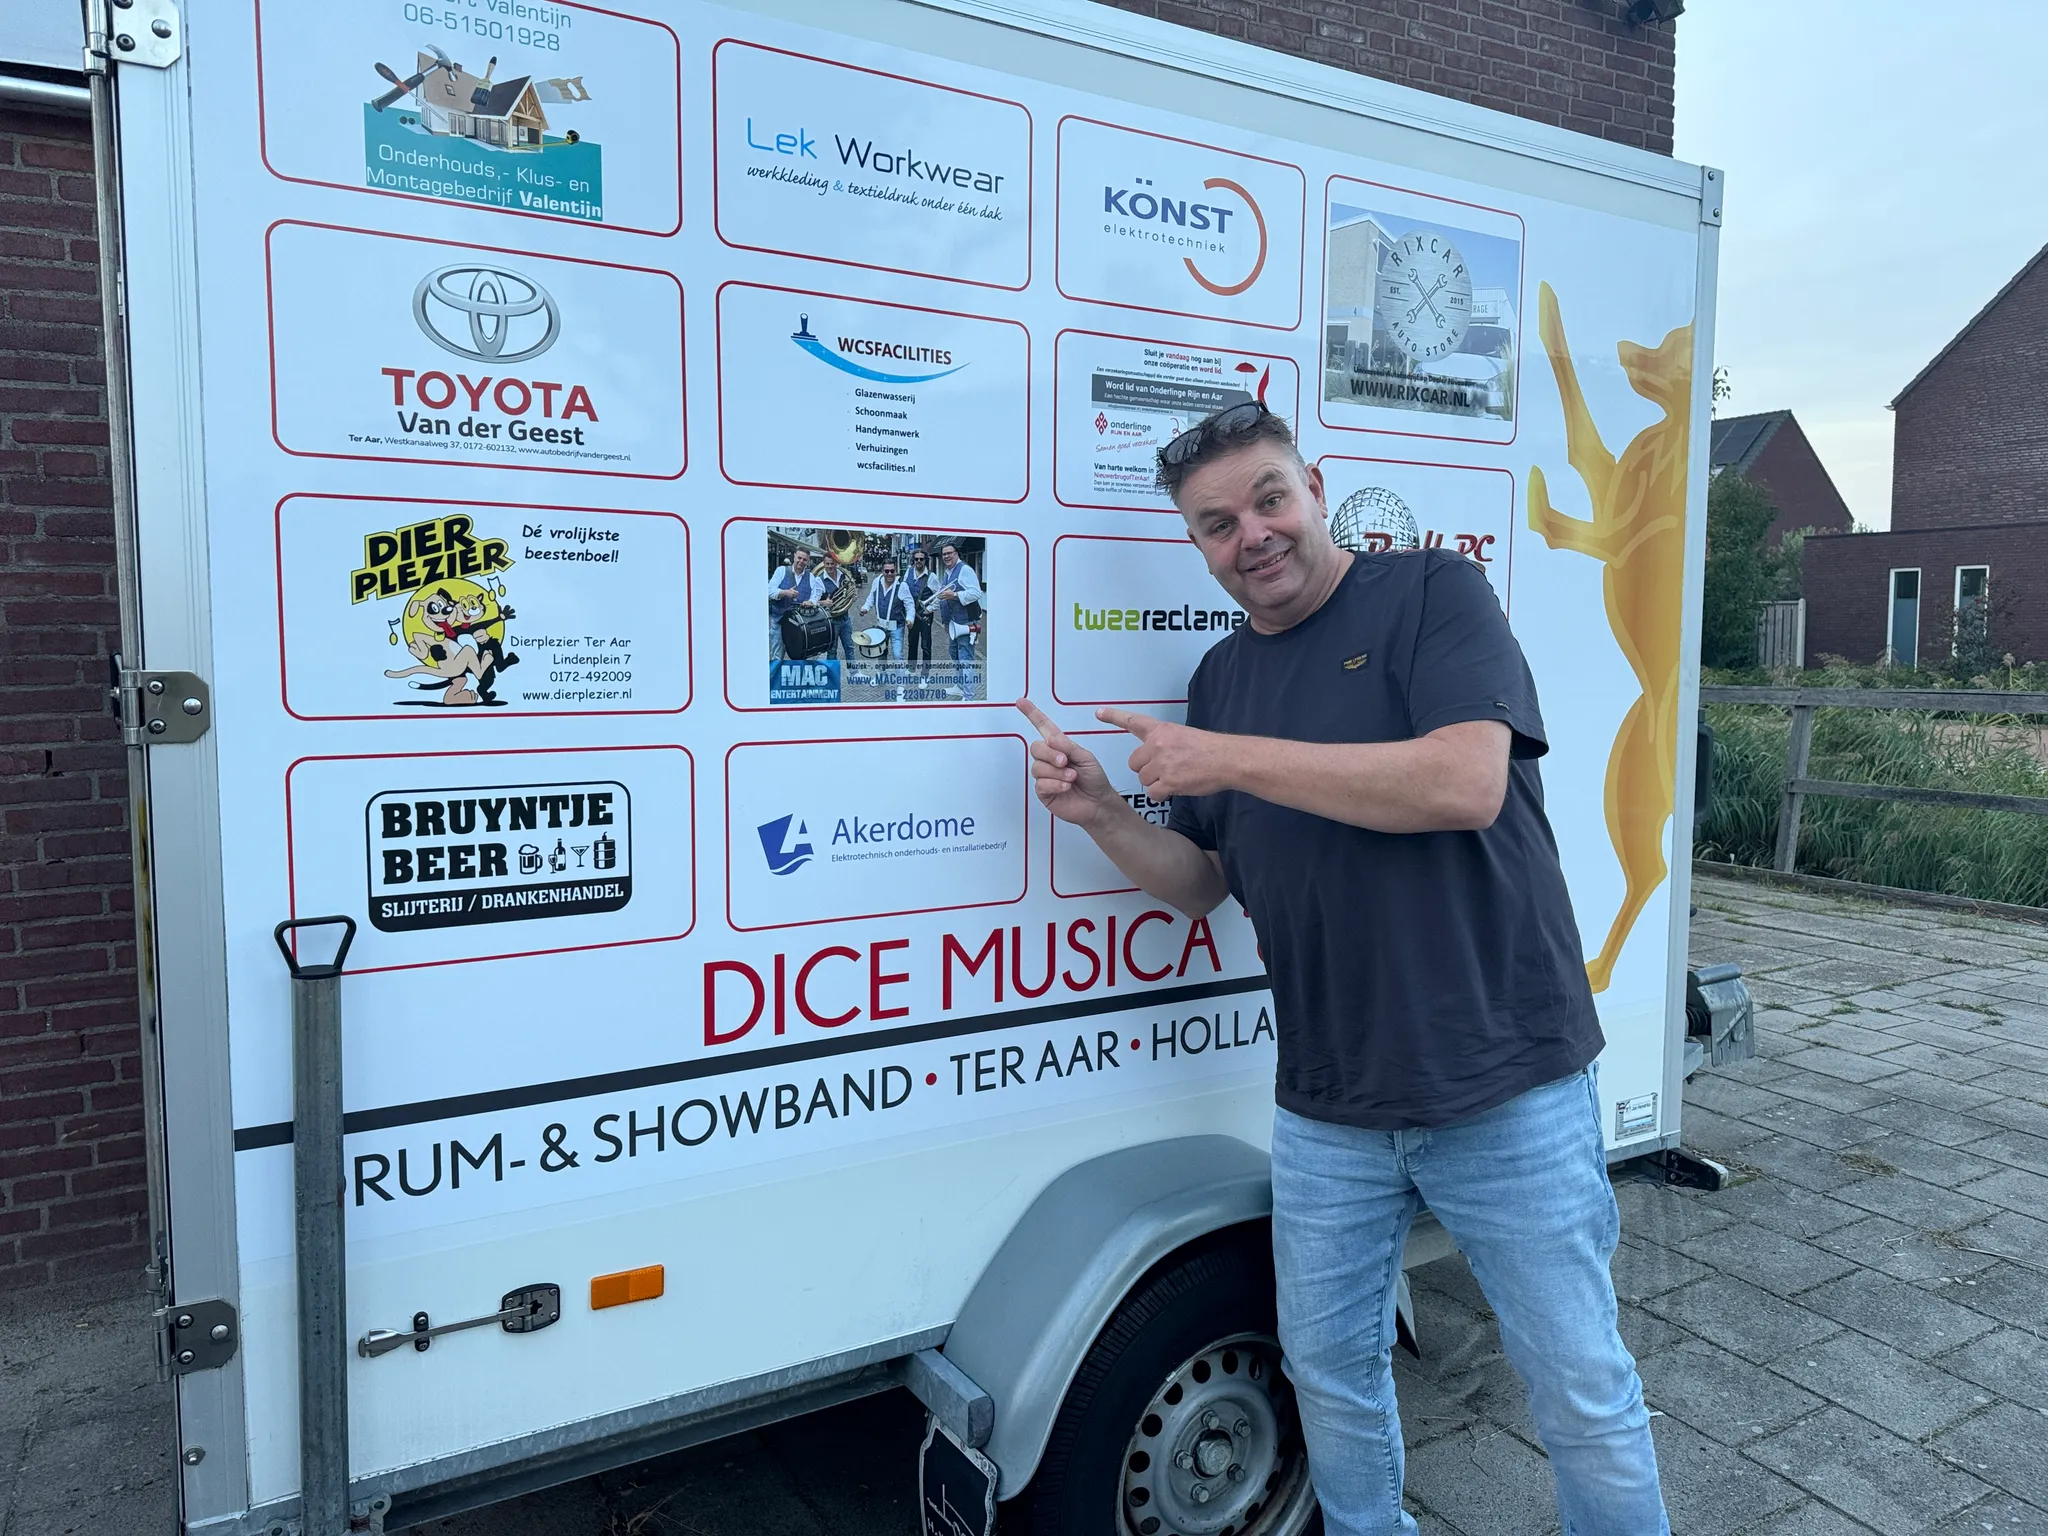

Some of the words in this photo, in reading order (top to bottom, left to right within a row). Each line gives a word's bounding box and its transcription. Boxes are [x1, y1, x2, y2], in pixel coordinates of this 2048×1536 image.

[487, 0, 571, 29] Valentijn
[404, 3, 560, 51] 06-51501928
[747, 117, 817, 159] Lek
[835, 134, 1004, 194] Workwear
[517, 166, 562, 187] Klus-
[569, 179, 590, 193] en
[366, 166, 512, 207] Montagebedrijf
[519, 191, 602, 218] Valentijn
[747, 165, 829, 196] werkkleding
[833, 180, 844, 192] &
[847, 182, 919, 205] textieldruk
[921, 197, 955, 211] onder
[957, 201, 978, 216] één
[979, 205, 1003, 221] dak
[1104, 177, 1233, 234] KÖNST
[1104, 223, 1226, 253] elektrotechniek
[1391, 236, 1464, 278] RIXCAR
[1390, 286, 1401, 295] EST.
[1450, 297, 1464, 305] 2015
[1473, 305, 1488, 313] RAGE
[1392, 321, 1417, 352] AUTO
[1426, 329, 1458, 356] STORE
[838, 336, 952, 365] WCSFACILITIES
[1144, 348, 1158, 357] Sluit
[1159, 351, 1164, 359] je
[1166, 353, 1189, 362] vandaag
[1191, 355, 1202, 364] nog
[1160, 361, 1190, 370] coöperatie
[381, 367, 599, 422] TOYOTA
[855, 388, 916, 404] Glazenwasserij
[1105, 380, 1124, 390] Word
[1125, 382, 1134, 391] lid
[1135, 385, 1148, 393] van
[1150, 385, 1186, 398] Onderlinge
[1188, 390, 1200, 400] Rijn
[1211, 393, 1223, 401] Aar
[1350, 378, 1470, 408] WWW.RIXCAR.NL
[855, 406, 908, 420] Schoonmaak
[397, 411, 450, 435] Van
[458, 417, 502, 439] der
[508, 420, 585, 446] Geest
[855, 424, 920, 439] Handymanwerk
[1110, 421, 1151, 433] onderlinge
[349, 434, 363, 442] Ter
[364, 435, 383, 444] Aar,
[385, 437, 448, 449] Westkanaalweg
[450, 441, 462, 449] 37,
[463, 442, 517, 453] 0172-602132,
[518, 447, 631, 461] www.autobedrijfvandergeest.nl
[855, 442, 909, 456] Verhuizingen
[857, 461, 916, 473] wcsfacilities.nl
[1094, 462, 1106, 470] Van
[368, 517, 477, 569] DIER
[522, 524, 542, 539] Dé
[549, 526, 620, 544] vrolijkste
[524, 546, 619, 563] beestenboel!
[355, 542, 513, 600] PLEZIER
[510, 636, 580, 650] Dierplezier
[584, 636, 605, 647] Ter
[609, 637, 631, 648] Aar
[553, 654, 620, 667] Lindenplein
[624, 654, 631, 664] 7
[550, 671, 632, 682] 0172-492009
[781, 664, 828, 686] MAC
[847, 673, 981, 685] www.MACentertainment.nl
[523, 689, 632, 702] www.dierplezier.nl
[770, 689, 838, 699] ENTERTAINMENT
[885, 689, 947, 700] 06-22307708
[381, 792, 613, 839] BRUYNTJE
[1139, 809, 1169, 824] CT
[831, 813, 975, 845] Akerdome
[831, 851, 893, 862] Elektrotechnisch
[894, 846, 940, 857] onderhouds-
[952, 841, 1007, 853] installatiebedrijf
[383, 842, 508, 885] BEER
[381, 897, 463, 918] SLIJTERIJ
[468, 894, 477, 912] /
[482, 883, 624, 910] DRANKENHANDEL
[703, 938, 910, 1047] DICE
[941, 909, 1222, 1011] MUSICA
[340, 1132, 526, 1207] RUM-
[540, 1122, 580, 1173] &
[593, 1064, 913, 1164] SHOWBAND
[949, 1044, 1026, 1096] TER
[1035, 1029, 1120, 1082] AAR
[1152, 1006, 1275, 1060] HOLLA
